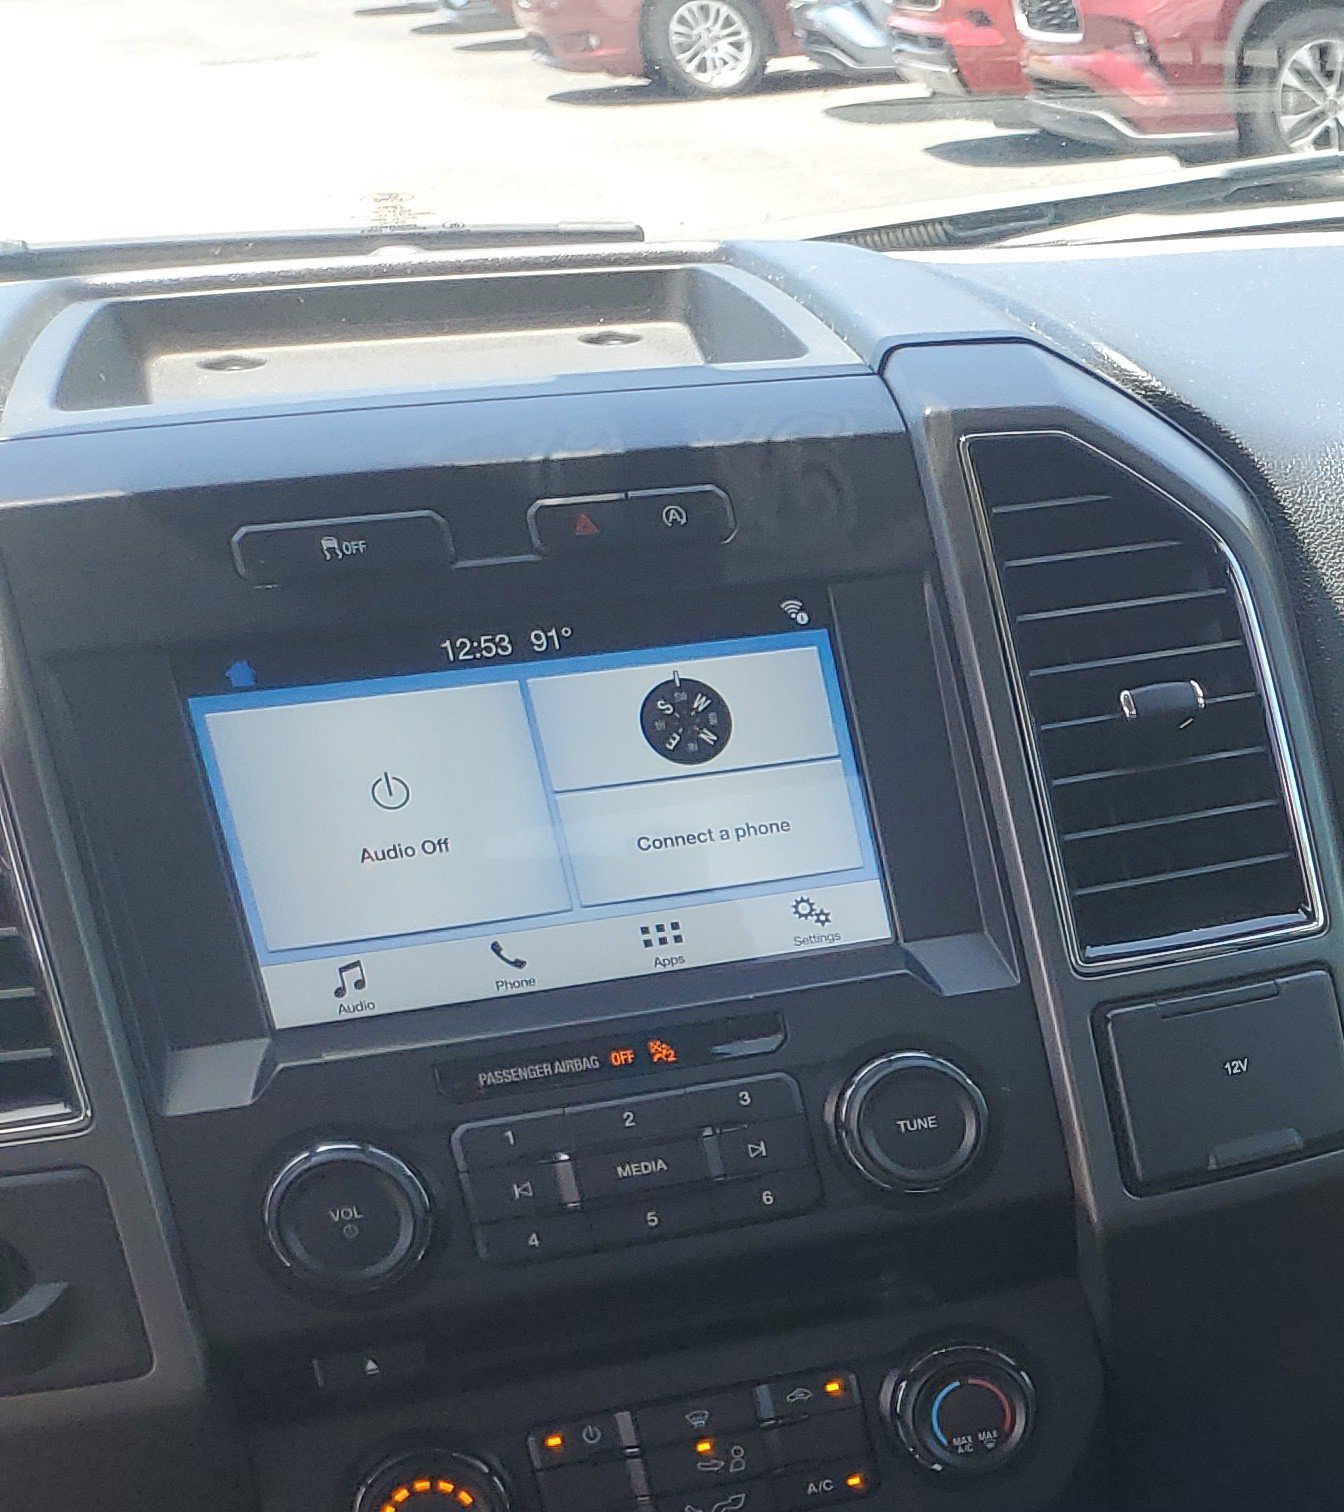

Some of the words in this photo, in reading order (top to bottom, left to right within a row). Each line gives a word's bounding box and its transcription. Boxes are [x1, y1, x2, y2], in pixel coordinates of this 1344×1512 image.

[341, 539, 367, 556] OFF
[441, 633, 513, 663] 12:53
[636, 826, 715, 853] Connect
[720, 828, 731, 841] a
[734, 818, 792, 844] phone
[359, 840, 417, 864] Audio
[420, 837, 451, 856] Off
[793, 931, 843, 948] Settings
[653, 954, 686, 969] Apps
[495, 976, 537, 992] Phone
[337, 1000, 376, 1015] Audio
[478, 1064, 551, 1087] PASSENGER
[554, 1056, 600, 1074] AIRBAG
[610, 1050, 635, 1067] OFF
[1224, 1058, 1248, 1075] 12V
[739, 1091, 751, 1106] 3
[622, 1111, 636, 1127] 2
[896, 1115, 939, 1133] TUNE
[503, 1130, 515, 1146] 1
[616, 1158, 668, 1179] MEDIA
[762, 1190, 775, 1205] 6
[328, 1206, 365, 1222] VOL
[646, 1211, 659, 1227] 5
[528, 1233, 541, 1247] 4
[806, 1479, 835, 1495] A/C
